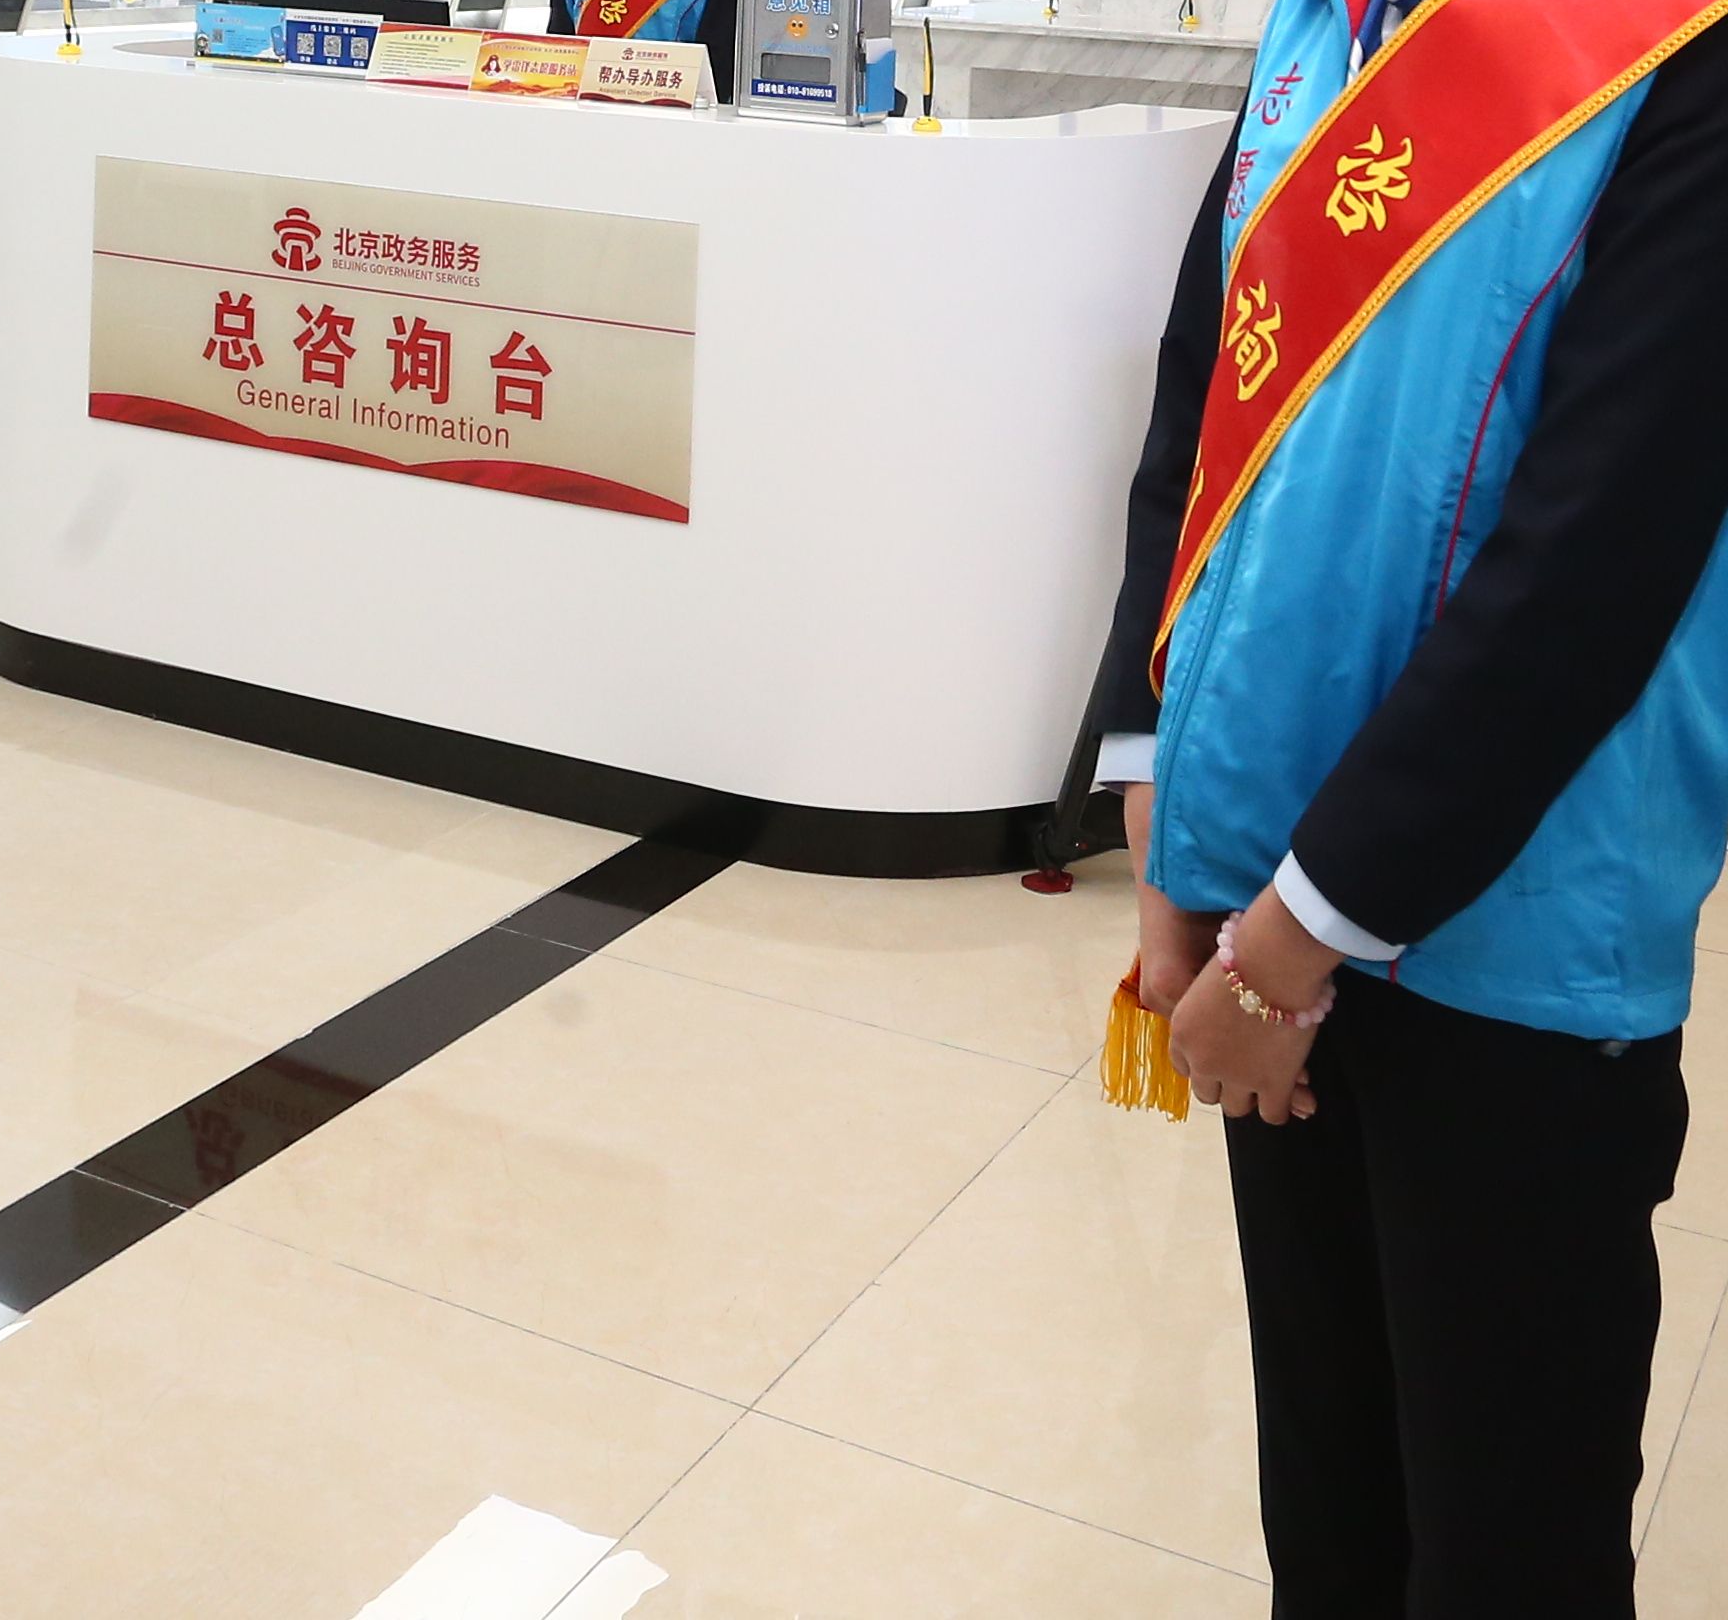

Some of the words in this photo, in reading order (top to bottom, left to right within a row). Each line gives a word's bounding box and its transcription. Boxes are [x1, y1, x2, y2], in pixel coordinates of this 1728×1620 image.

[599, 66, 683, 89] 帮办导办服务
[332, 258, 368, 273] BEIJING
[369, 263, 433, 282] GOVERNMENT
[435, 272, 481, 288] SERVICES
[333, 227, 481, 273] 北京政务服务
[202, 290, 553, 421] 总咨询台
[236, 379, 341, 422] General
[352, 398, 511, 450] Information
